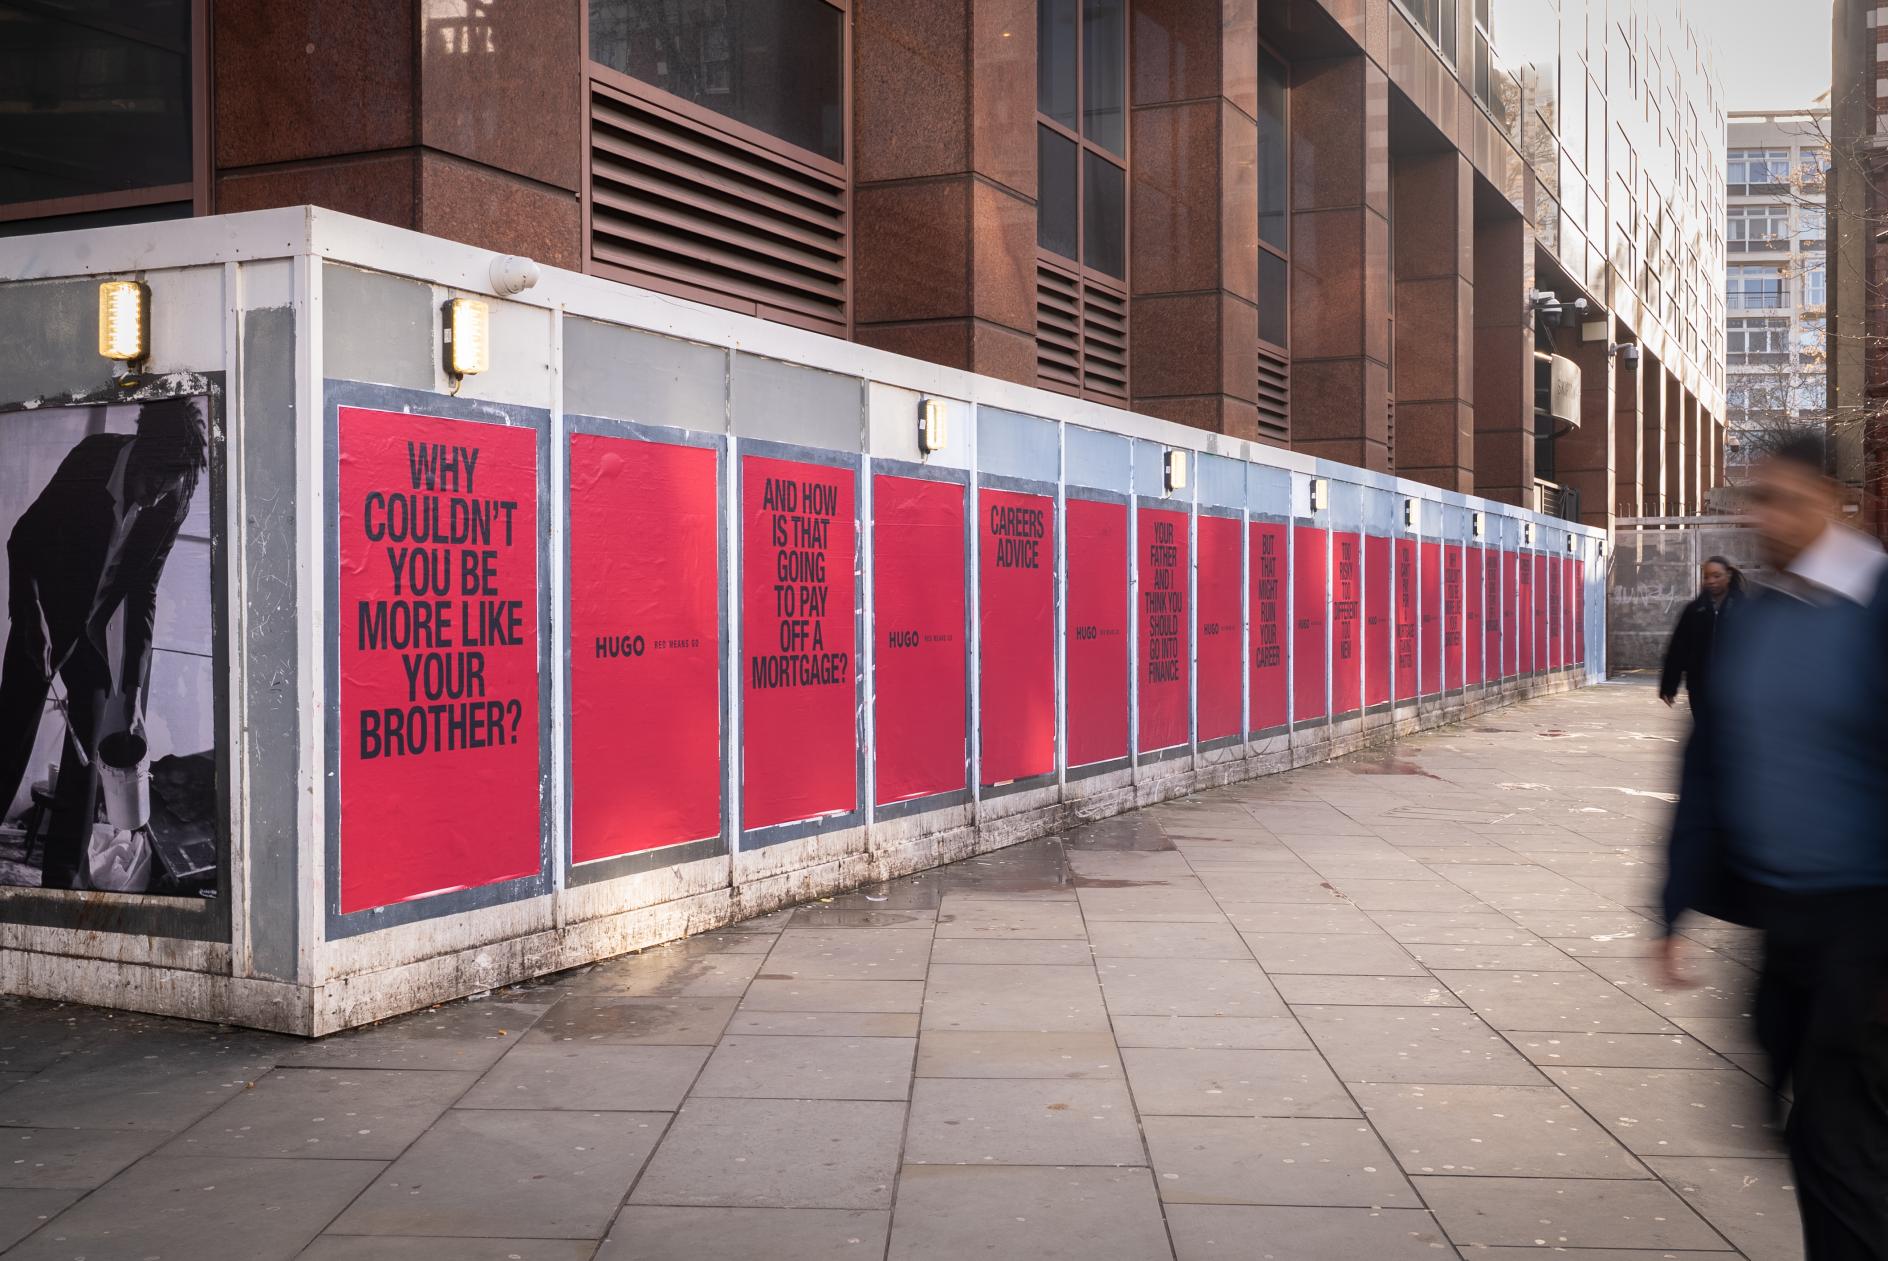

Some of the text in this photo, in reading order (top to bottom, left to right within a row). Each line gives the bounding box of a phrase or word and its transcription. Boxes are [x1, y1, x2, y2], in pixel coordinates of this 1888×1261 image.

[408, 441, 479, 493] WHY
[763, 478, 837, 516] AND HOW
[365, 492, 517, 546] COULDN'T
[991, 505, 1044, 538] CAREERS
[773, 514, 830, 549] IS THAT
[1154, 522, 1173, 544] YOUR
[997, 538, 1039, 569] ADVICE
[1150, 545, 1176, 567] FATHER
[1262, 534, 1274, 555] BUT
[387, 547, 498, 596] YOU BE
[778, 549, 825, 583] GOING
[1261, 557, 1276, 577] THAT
[1154, 569, 1168, 590] AND
[774, 585, 828, 617] TO PAY
[1145, 592, 1182, 614] THINK YOU
[1261, 602, 1276, 622] RUIN
[358, 600, 523, 650] MORE LIKE
[781, 620, 823, 652] OFF A
[1077, 626, 1096, 640] HUGO
[1150, 615, 1178, 637] SHOULD
[1204, 623, 1219, 635] HUGO
[1260, 624, 1277, 644] YOUR
[596, 635, 645, 658] HUGO
[889, 631, 919, 648] HUGO
[1150, 637, 1178, 660] GO INTO
[1256, 645, 1280, 668] CAREER
[402, 652, 485, 701] YOUR
[752, 653, 847, 689] MORTGAGE?
[1149, 660, 1179, 682] FINANCE
[360, 699, 522, 759] BROTHER?
